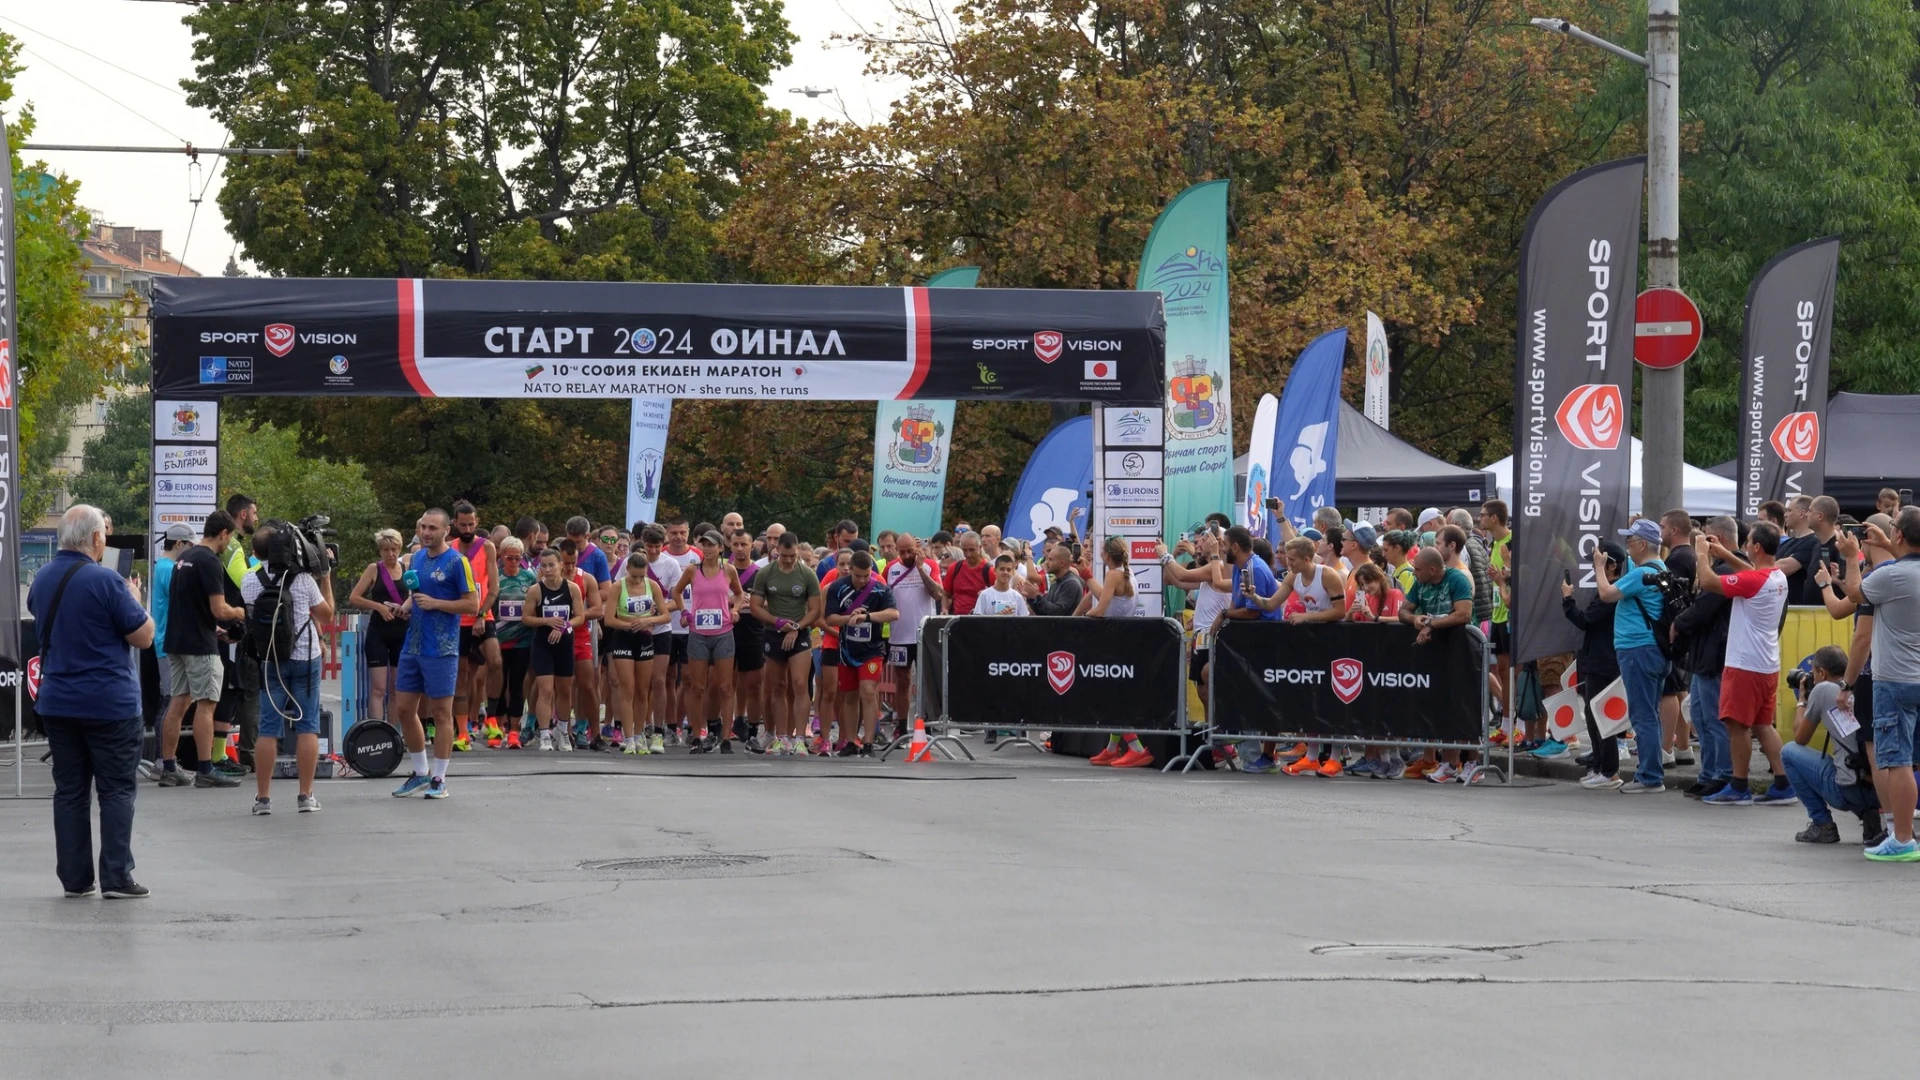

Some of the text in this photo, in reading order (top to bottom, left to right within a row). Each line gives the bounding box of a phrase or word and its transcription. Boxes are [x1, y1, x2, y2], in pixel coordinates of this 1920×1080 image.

[1165, 281, 1212, 303] 2024
[1586, 238, 1611, 370] SPORT
[200, 332, 357, 345] SPORT VISION
[484, 327, 847, 356] СТАРТ 2024 ФИНАЛ
[972, 339, 1121, 351] SPORT VISION
[1794, 300, 1814, 401] SPORT
[228, 360, 250, 368] NATO
[227, 373, 250, 381] OTAN
[581, 365, 636, 377] СОФИЯ
[642, 365, 700, 378] ЕКИДЕН
[707, 366, 782, 378] МАРАТОН
[524, 383, 563, 394] NATO
[566, 383, 606, 394] RELAY
[609, 383, 687, 395] MARATHON
[699, 383, 721, 395] she
[724, 386, 758, 397] runs,
[760, 383, 777, 395] he
[780, 386, 809, 395] runs
[1525, 308, 1547, 517] www.sportvision.bg
[1119, 426, 1146, 437] 2024
[1745, 355, 1765, 516] www.sportvision.bg
[175, 483, 213, 491] EUROINS
[883, 475, 911, 486] Обичам
[881, 489, 939, 503] Обичам София!
[1123, 487, 1159, 495] EUROINS
[508, 605, 515, 617] 9
[634, 601, 646, 612] 66
[702, 615, 714, 625] 28
[854, 627, 861, 638] 3
[988, 662, 1134, 678] SPORT VISION
[1263, 668, 1430, 689] SPORT VISION
[357, 741, 393, 754] MYLAPS
